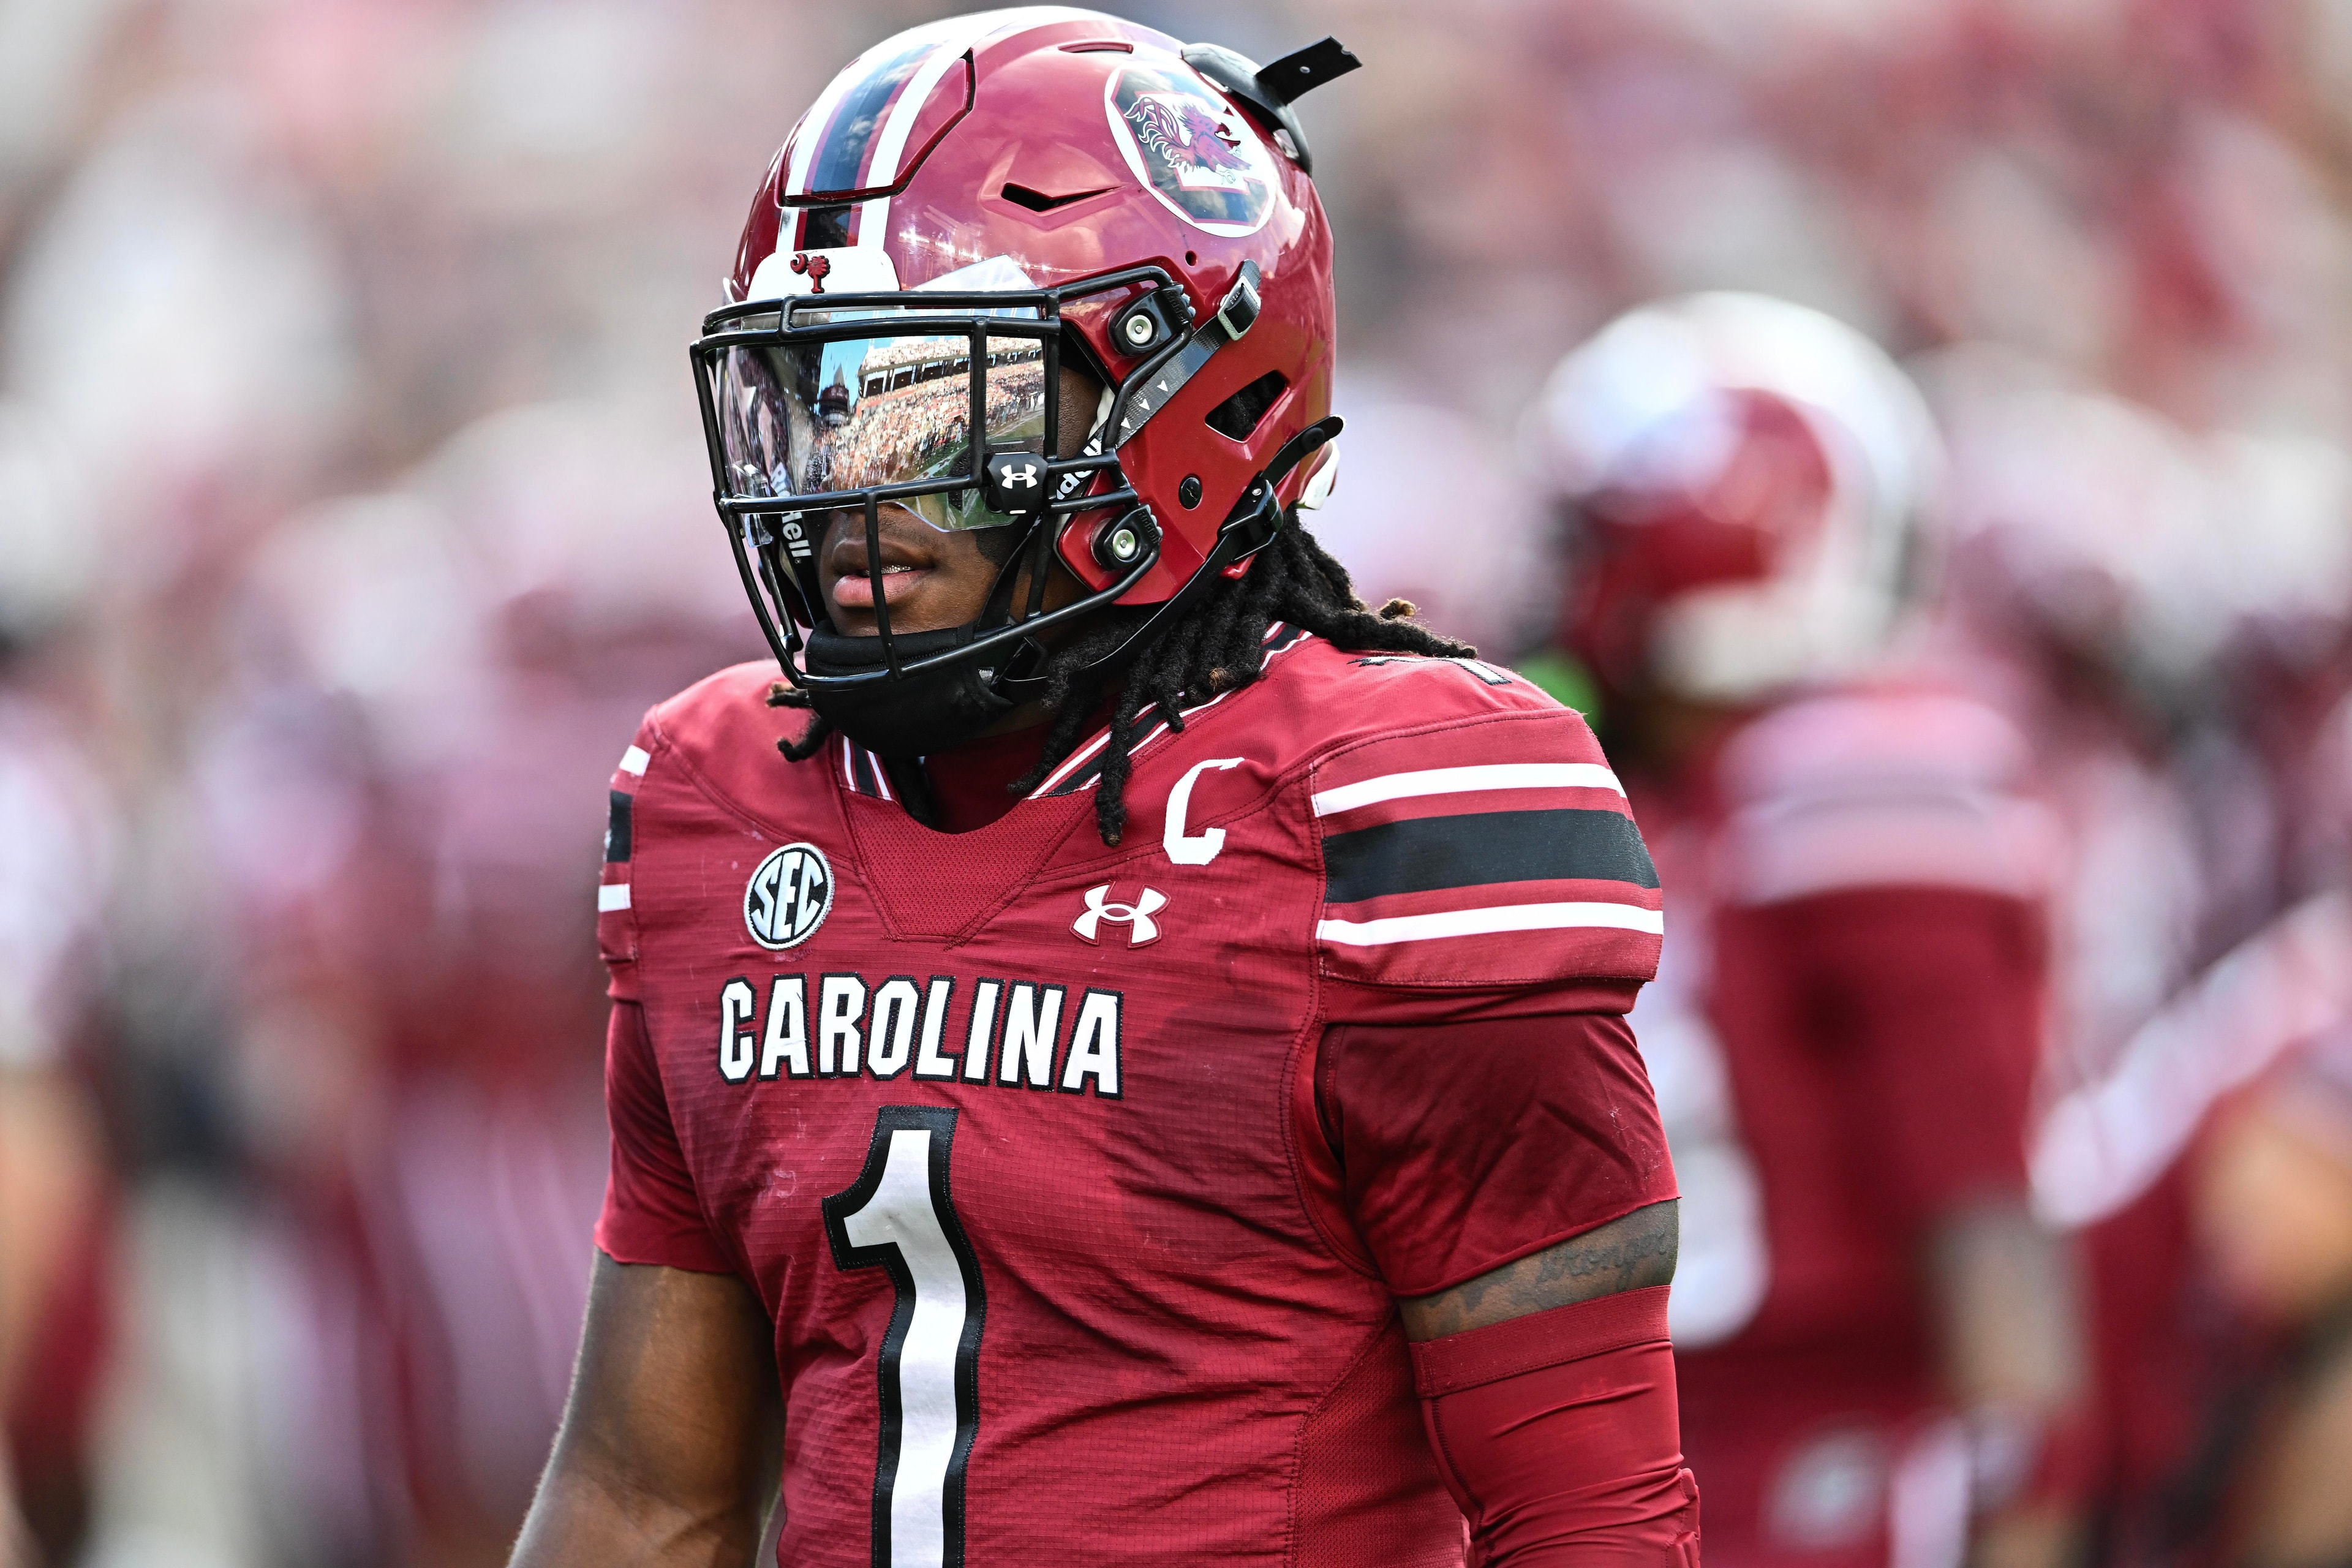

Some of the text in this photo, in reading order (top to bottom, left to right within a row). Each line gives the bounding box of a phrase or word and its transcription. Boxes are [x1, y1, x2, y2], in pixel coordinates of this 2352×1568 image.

[1138, 511, 1159, 544] Riddell
[1162, 756, 1245, 866] C
[750, 851, 824, 941] SEC
[717, 971, 1124, 1101] CAROLINA
[821, 1105, 988, 1568] 1
